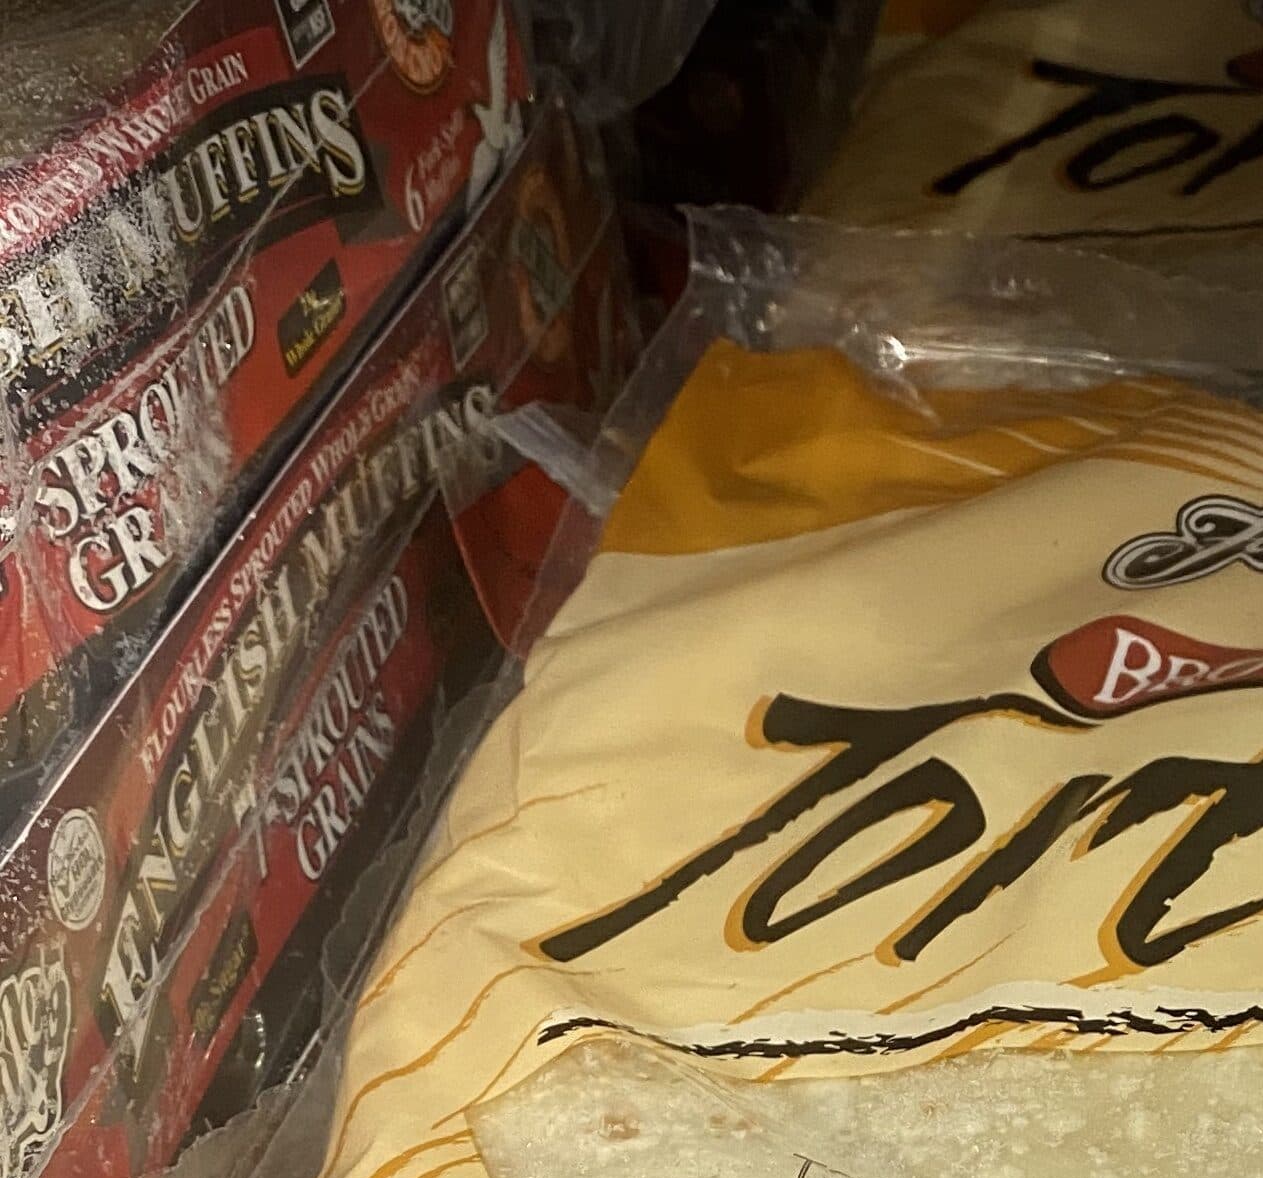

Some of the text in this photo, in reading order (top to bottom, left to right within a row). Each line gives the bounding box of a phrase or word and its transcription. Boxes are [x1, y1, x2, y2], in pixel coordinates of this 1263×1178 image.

[187, 52, 249, 105] GRAIN
[229, 478, 312, 611] SPROUTED
[267, 575, 408, 824] SPROUTED
[298, 692, 396, 882] GRAINS
[101, 562, 299, 1084] ENGLISH
